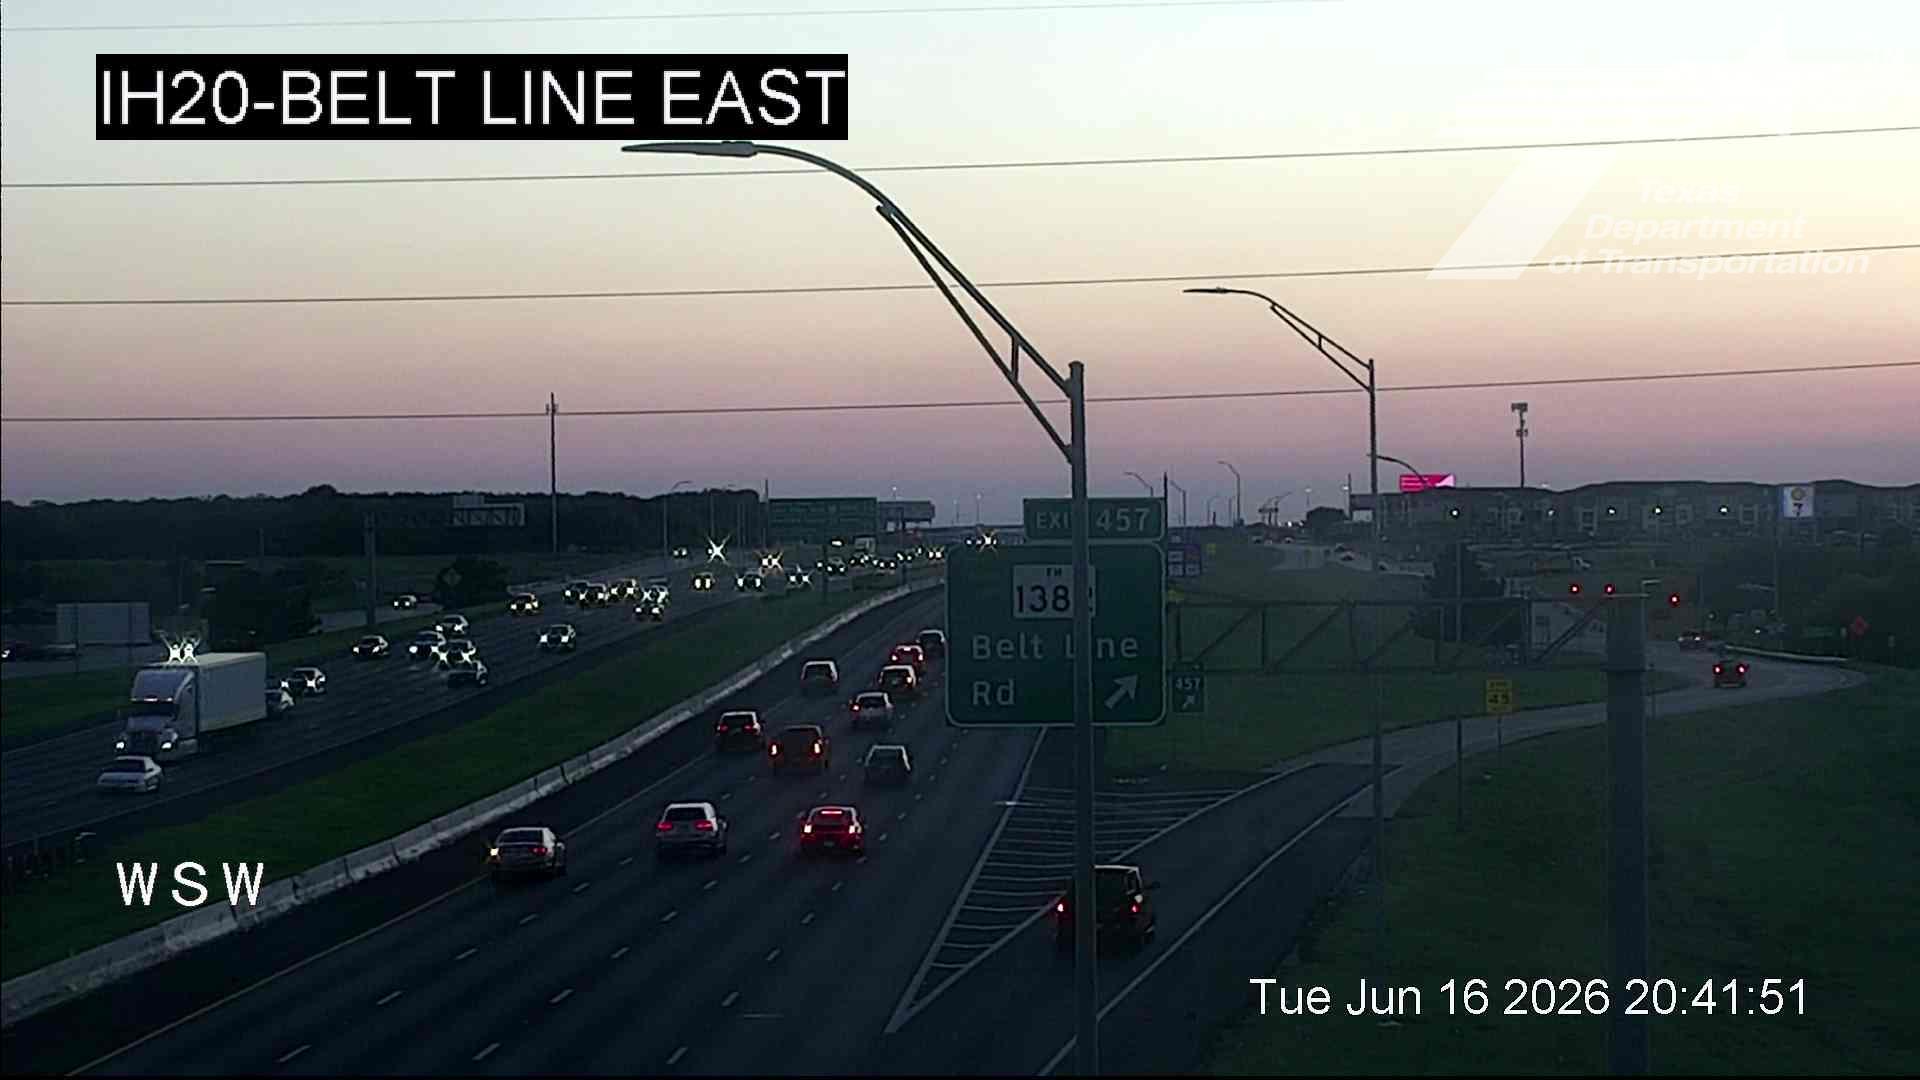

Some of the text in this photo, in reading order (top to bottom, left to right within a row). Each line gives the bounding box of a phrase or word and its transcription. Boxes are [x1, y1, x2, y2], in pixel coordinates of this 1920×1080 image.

[1036, 508, 1150, 532] EXI 457
[1016, 584, 1093, 613] 138
[972, 633, 1139, 660] Belt Lne
[972, 679, 1016, 706] Rd
